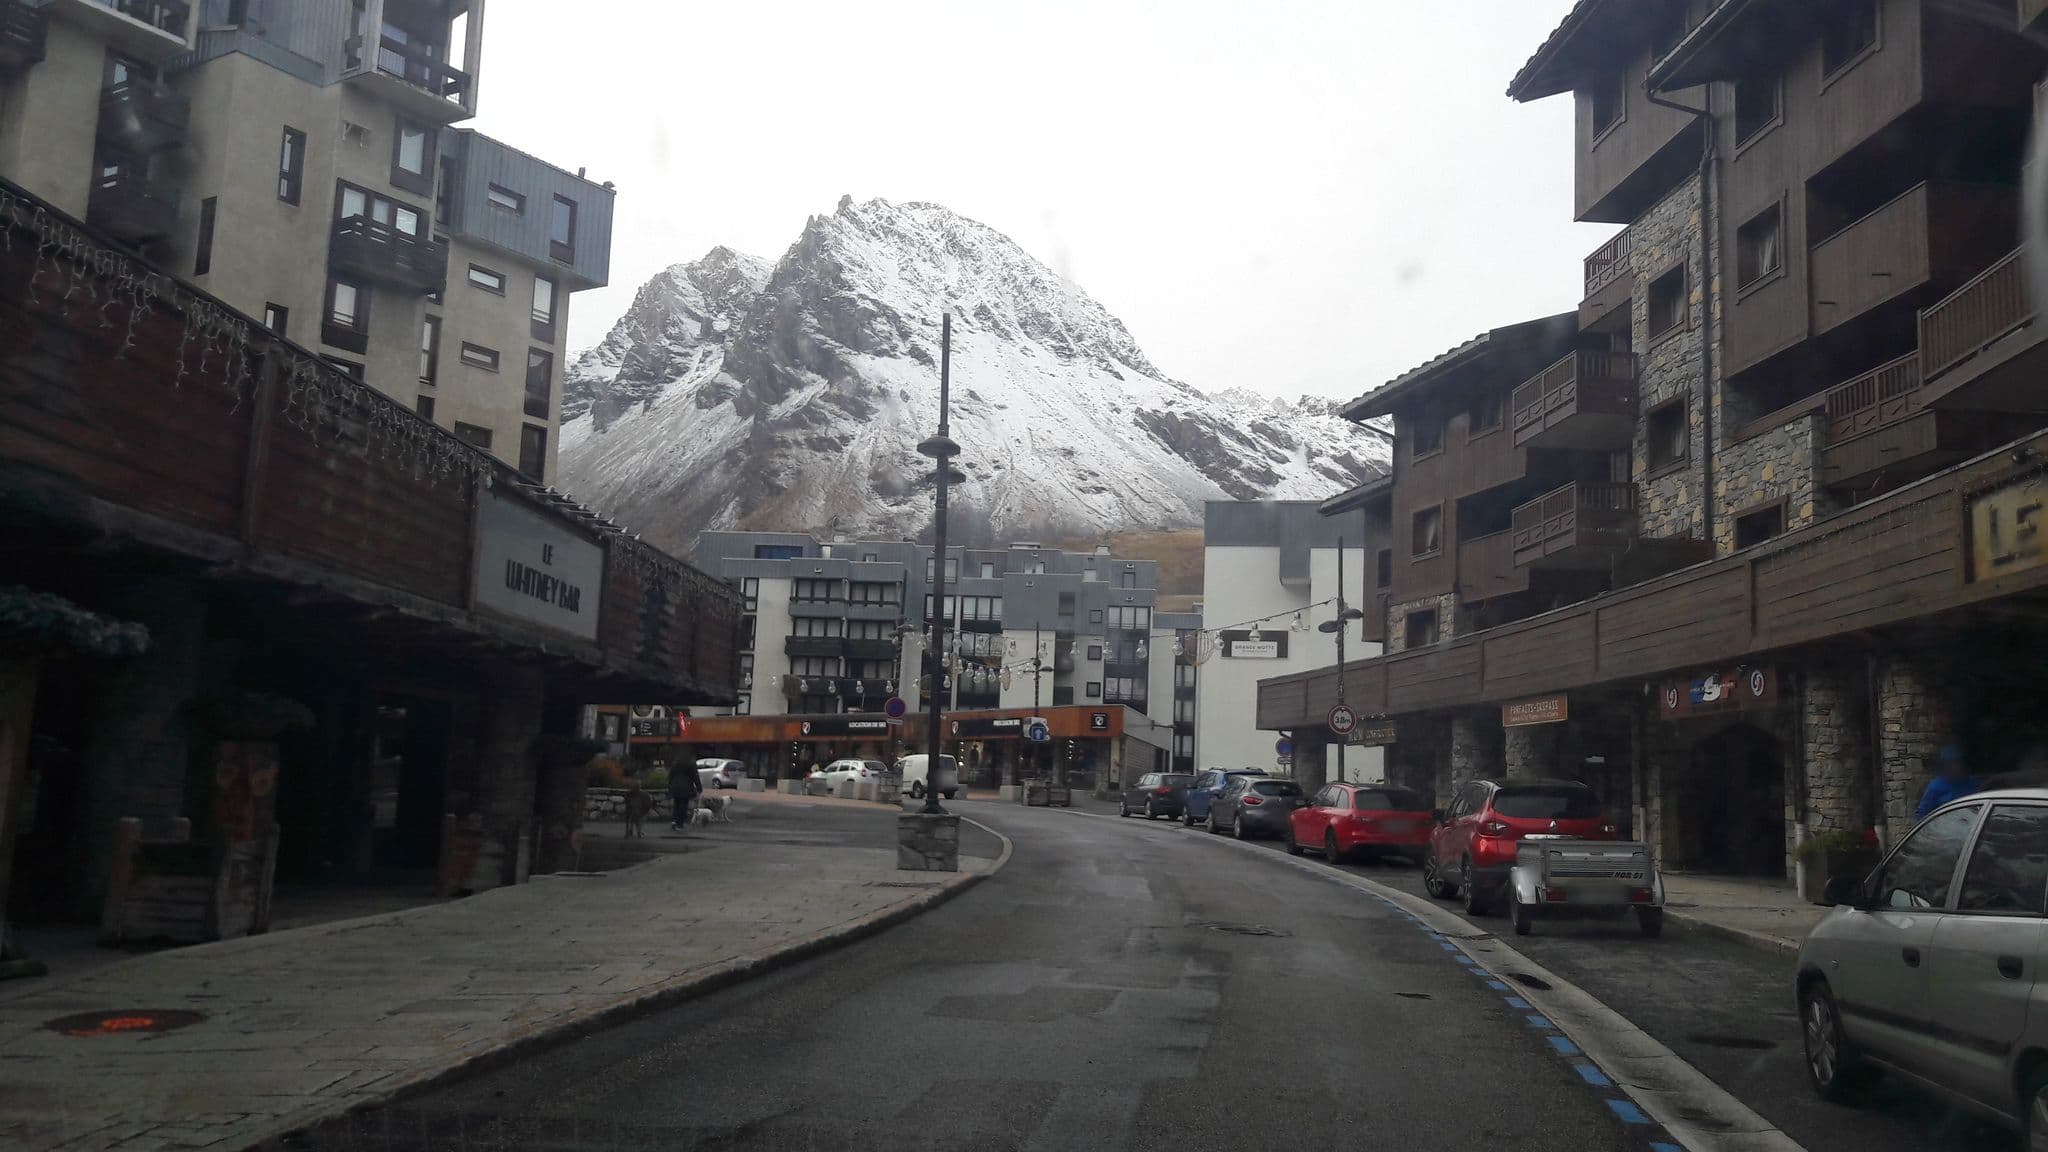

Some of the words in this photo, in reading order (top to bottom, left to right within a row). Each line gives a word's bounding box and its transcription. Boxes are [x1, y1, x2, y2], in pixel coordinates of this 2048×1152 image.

[542, 543, 553, 566] LE
[505, 558, 559, 605] WHITNEY
[559, 580, 581, 614] BAR
